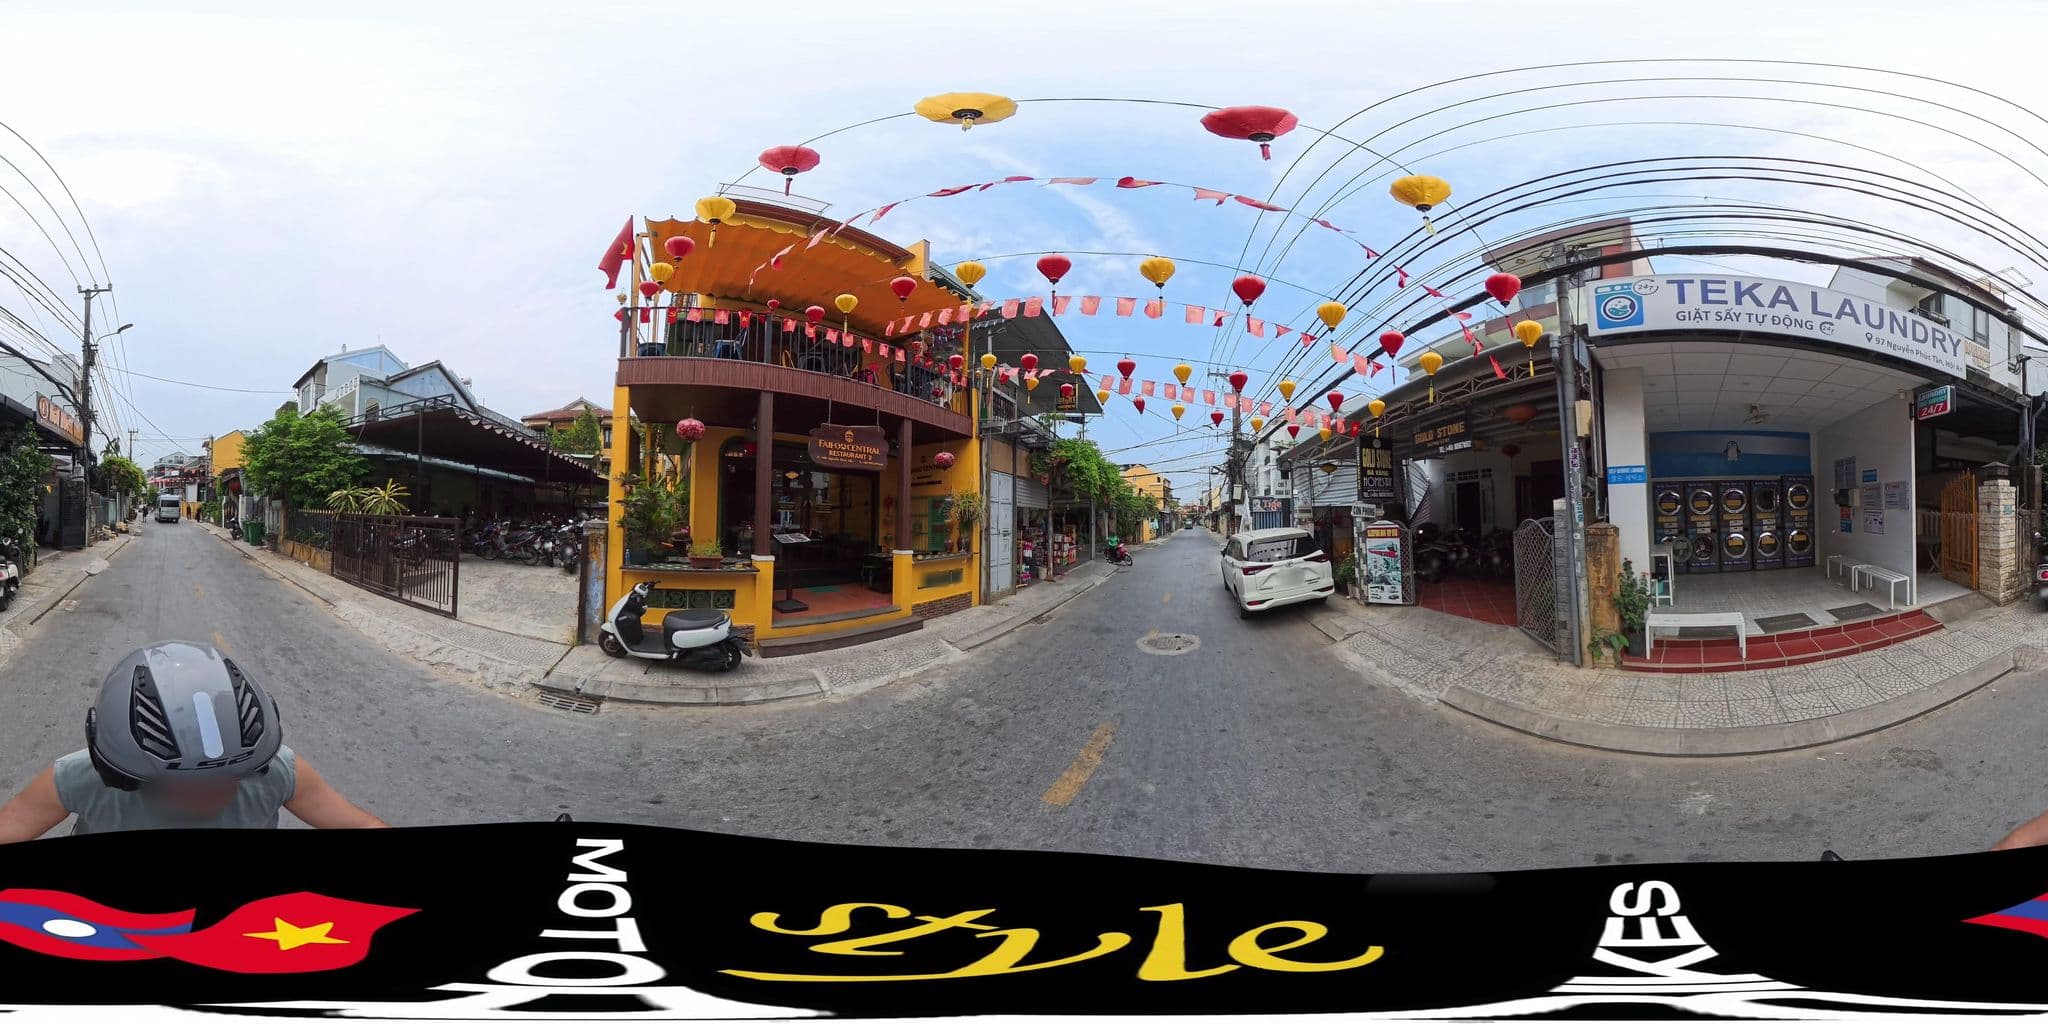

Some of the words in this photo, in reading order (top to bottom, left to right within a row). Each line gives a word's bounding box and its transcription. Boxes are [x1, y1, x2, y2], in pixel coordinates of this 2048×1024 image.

[1666, 279, 1799, 312] TEKA
[1811, 291, 1962, 357] LAUNDRY
[1675, 308, 1709, 328] GIẶT
[1714, 306, 1742, 322] SẤY
[1745, 312, 1768, 326] TỰ
[1771, 312, 1814, 331] ĐỘNG
[1875, 337, 1885, 346] 97
[1921, 402, 1945, 416] 24/7
[1414, 432, 1434, 445] GOLD
[1436, 421, 1465, 438] STONE
[829, 450, 867, 460] RESTAURANT
[846, 443, 880, 455] CENTRAL
[1362, 448, 1376, 468] GOLD
